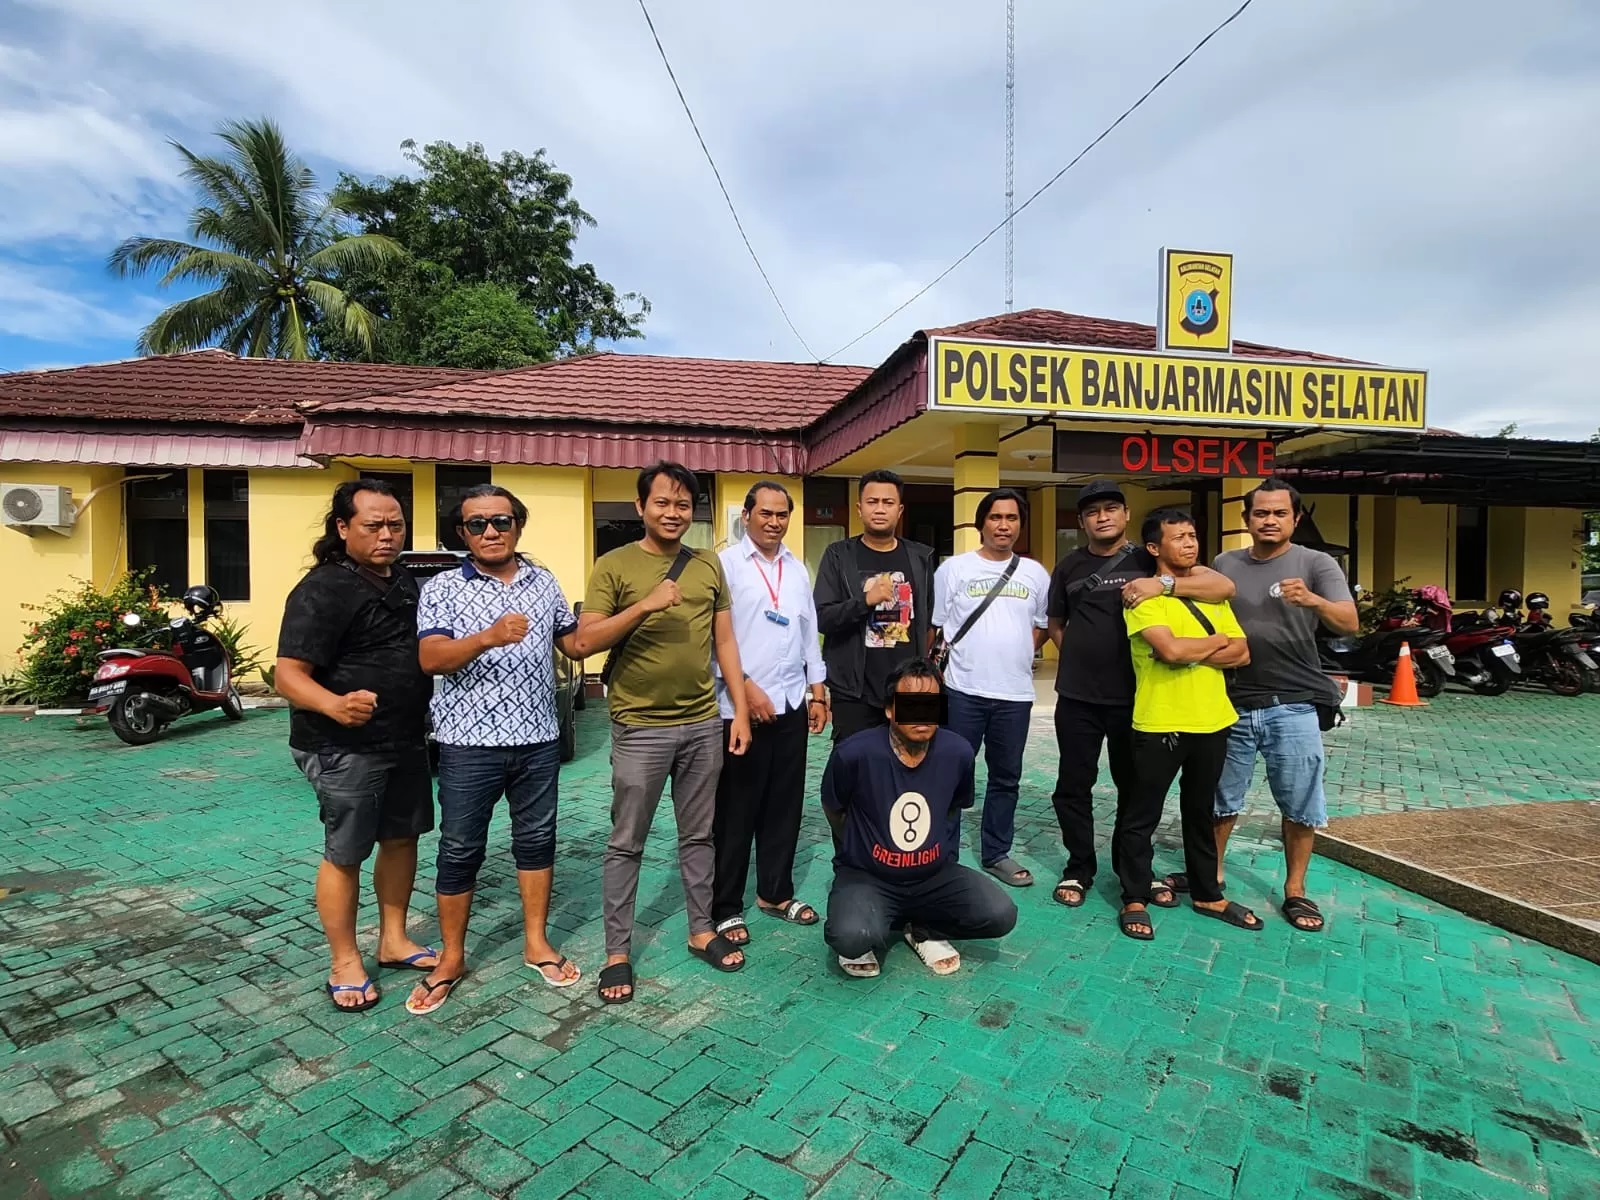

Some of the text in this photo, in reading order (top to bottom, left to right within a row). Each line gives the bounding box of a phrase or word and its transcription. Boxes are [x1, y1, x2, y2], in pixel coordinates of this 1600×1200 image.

[944, 349, 1420, 422] POLSEK BANJARMASIN SELATAN
[1121, 436, 1249, 475] OLSEK
[872, 843, 940, 868] GREENLIGHT
